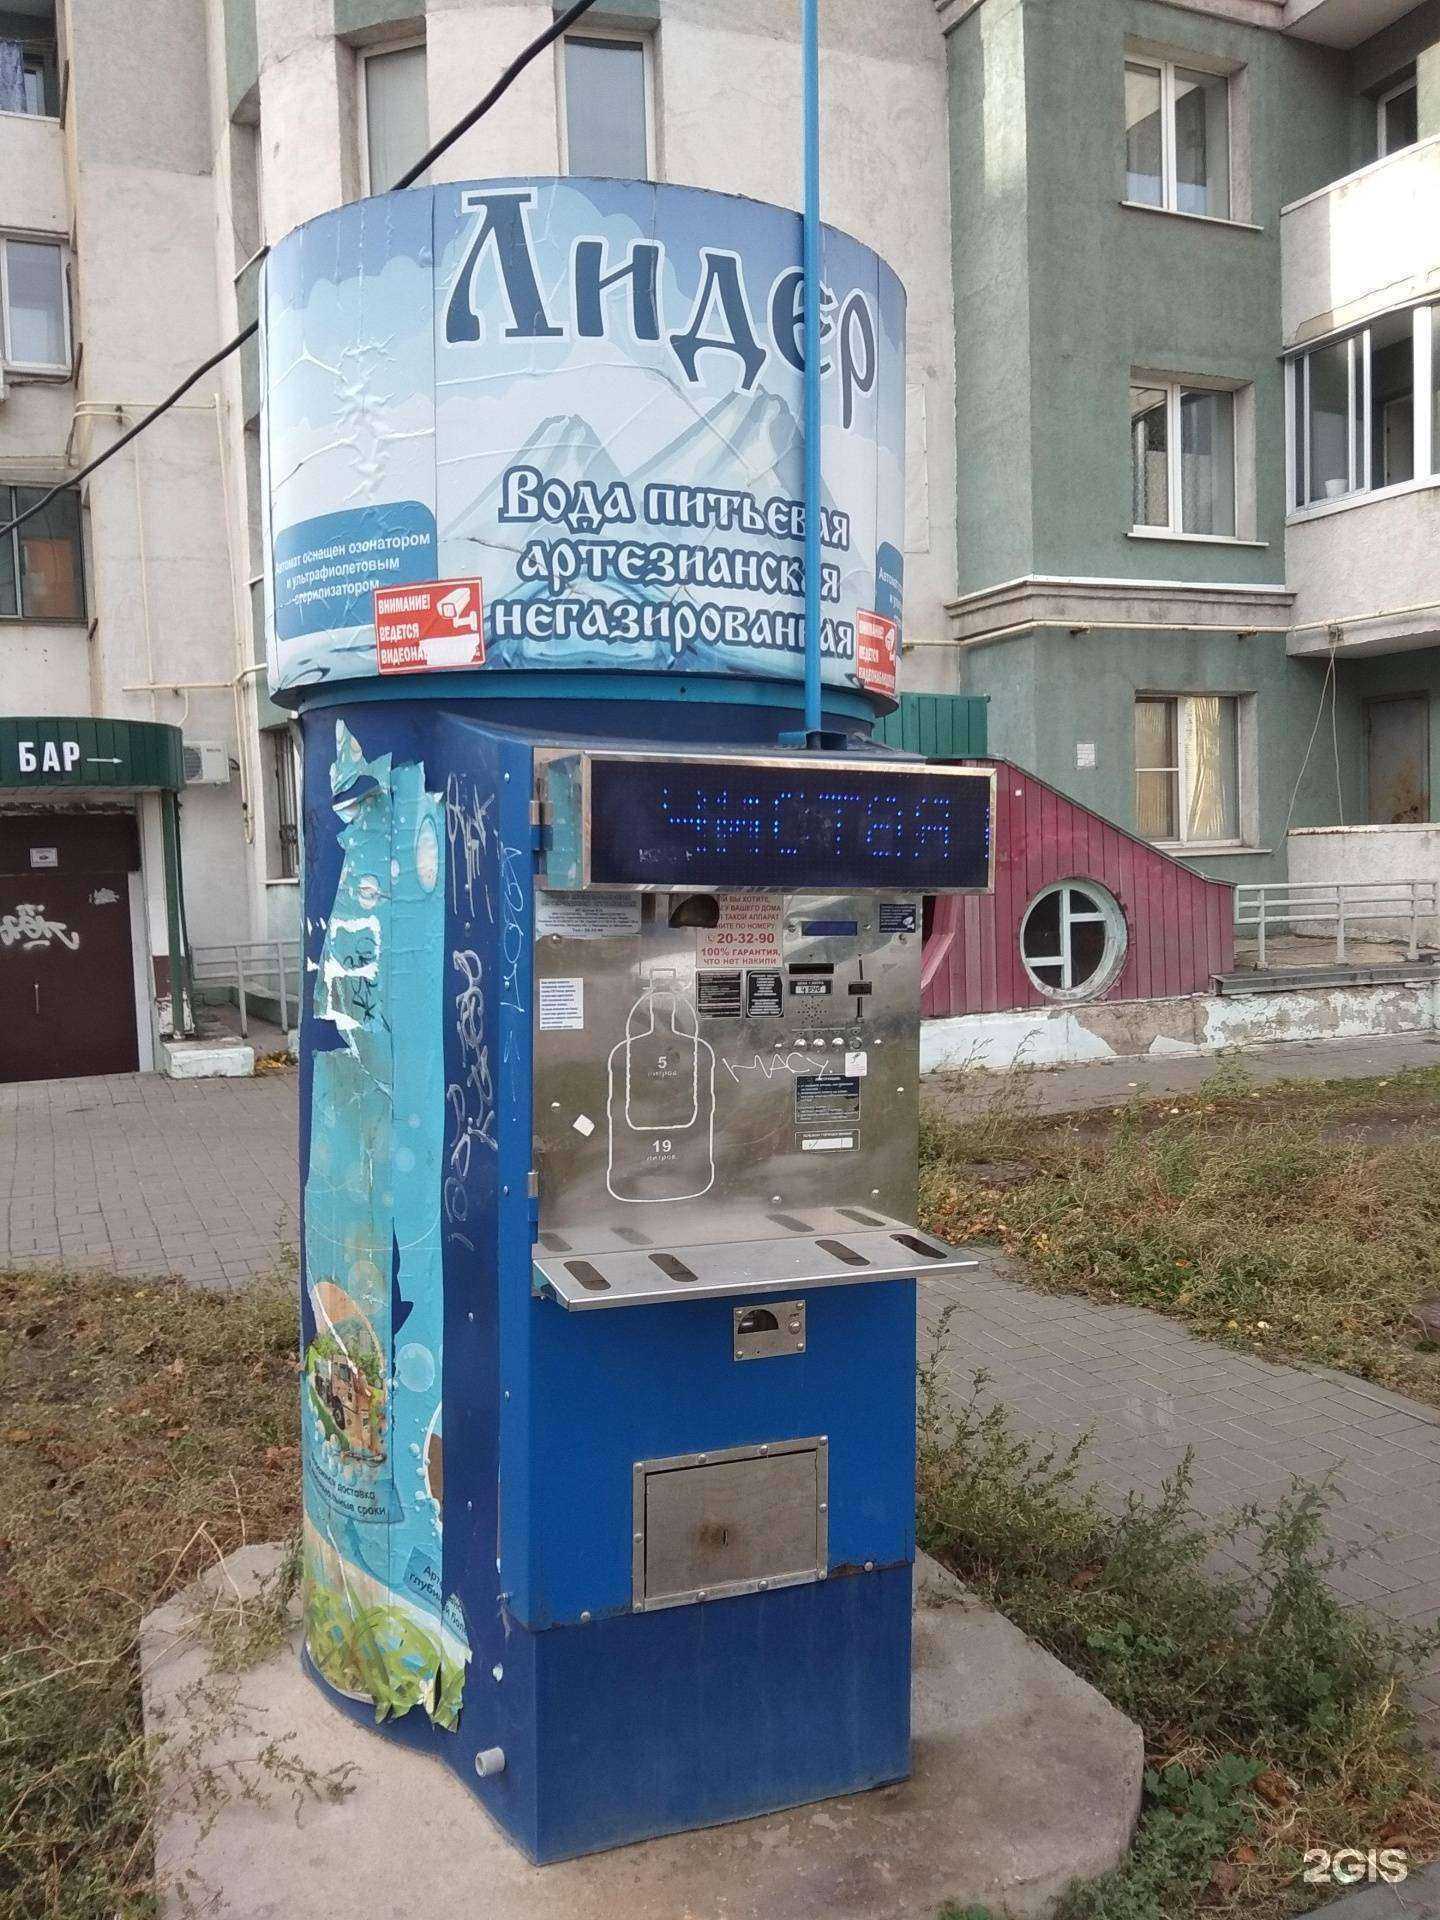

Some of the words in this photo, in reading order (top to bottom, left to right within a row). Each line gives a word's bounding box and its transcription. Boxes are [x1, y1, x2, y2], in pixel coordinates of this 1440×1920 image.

[443, 188, 878, 431] Лидер
[500, 466, 634, 531] Вода
[302, 543, 346, 564] оснащен
[348, 532, 431, 555] озонатором
[292, 556, 401, 590] ультрафиолетовым
[519, 541, 841, 600] артезианскя
[377, 593, 431, 615] ВНИМАНИЕ!
[379, 622, 420, 643] ВЕДЕТСЯ
[18, 741, 80, 772] БАР
[717, 932, 775, 944] 20-32-90
[701, 947, 729, 956] 100%
[703, 958, 720, 966] что
[657, 1056, 668, 1069] 5
[652, 1139, 672, 1153] 19
[337, 1483, 376, 1500] доставка
[357, 1505, 386, 1517] сроки
